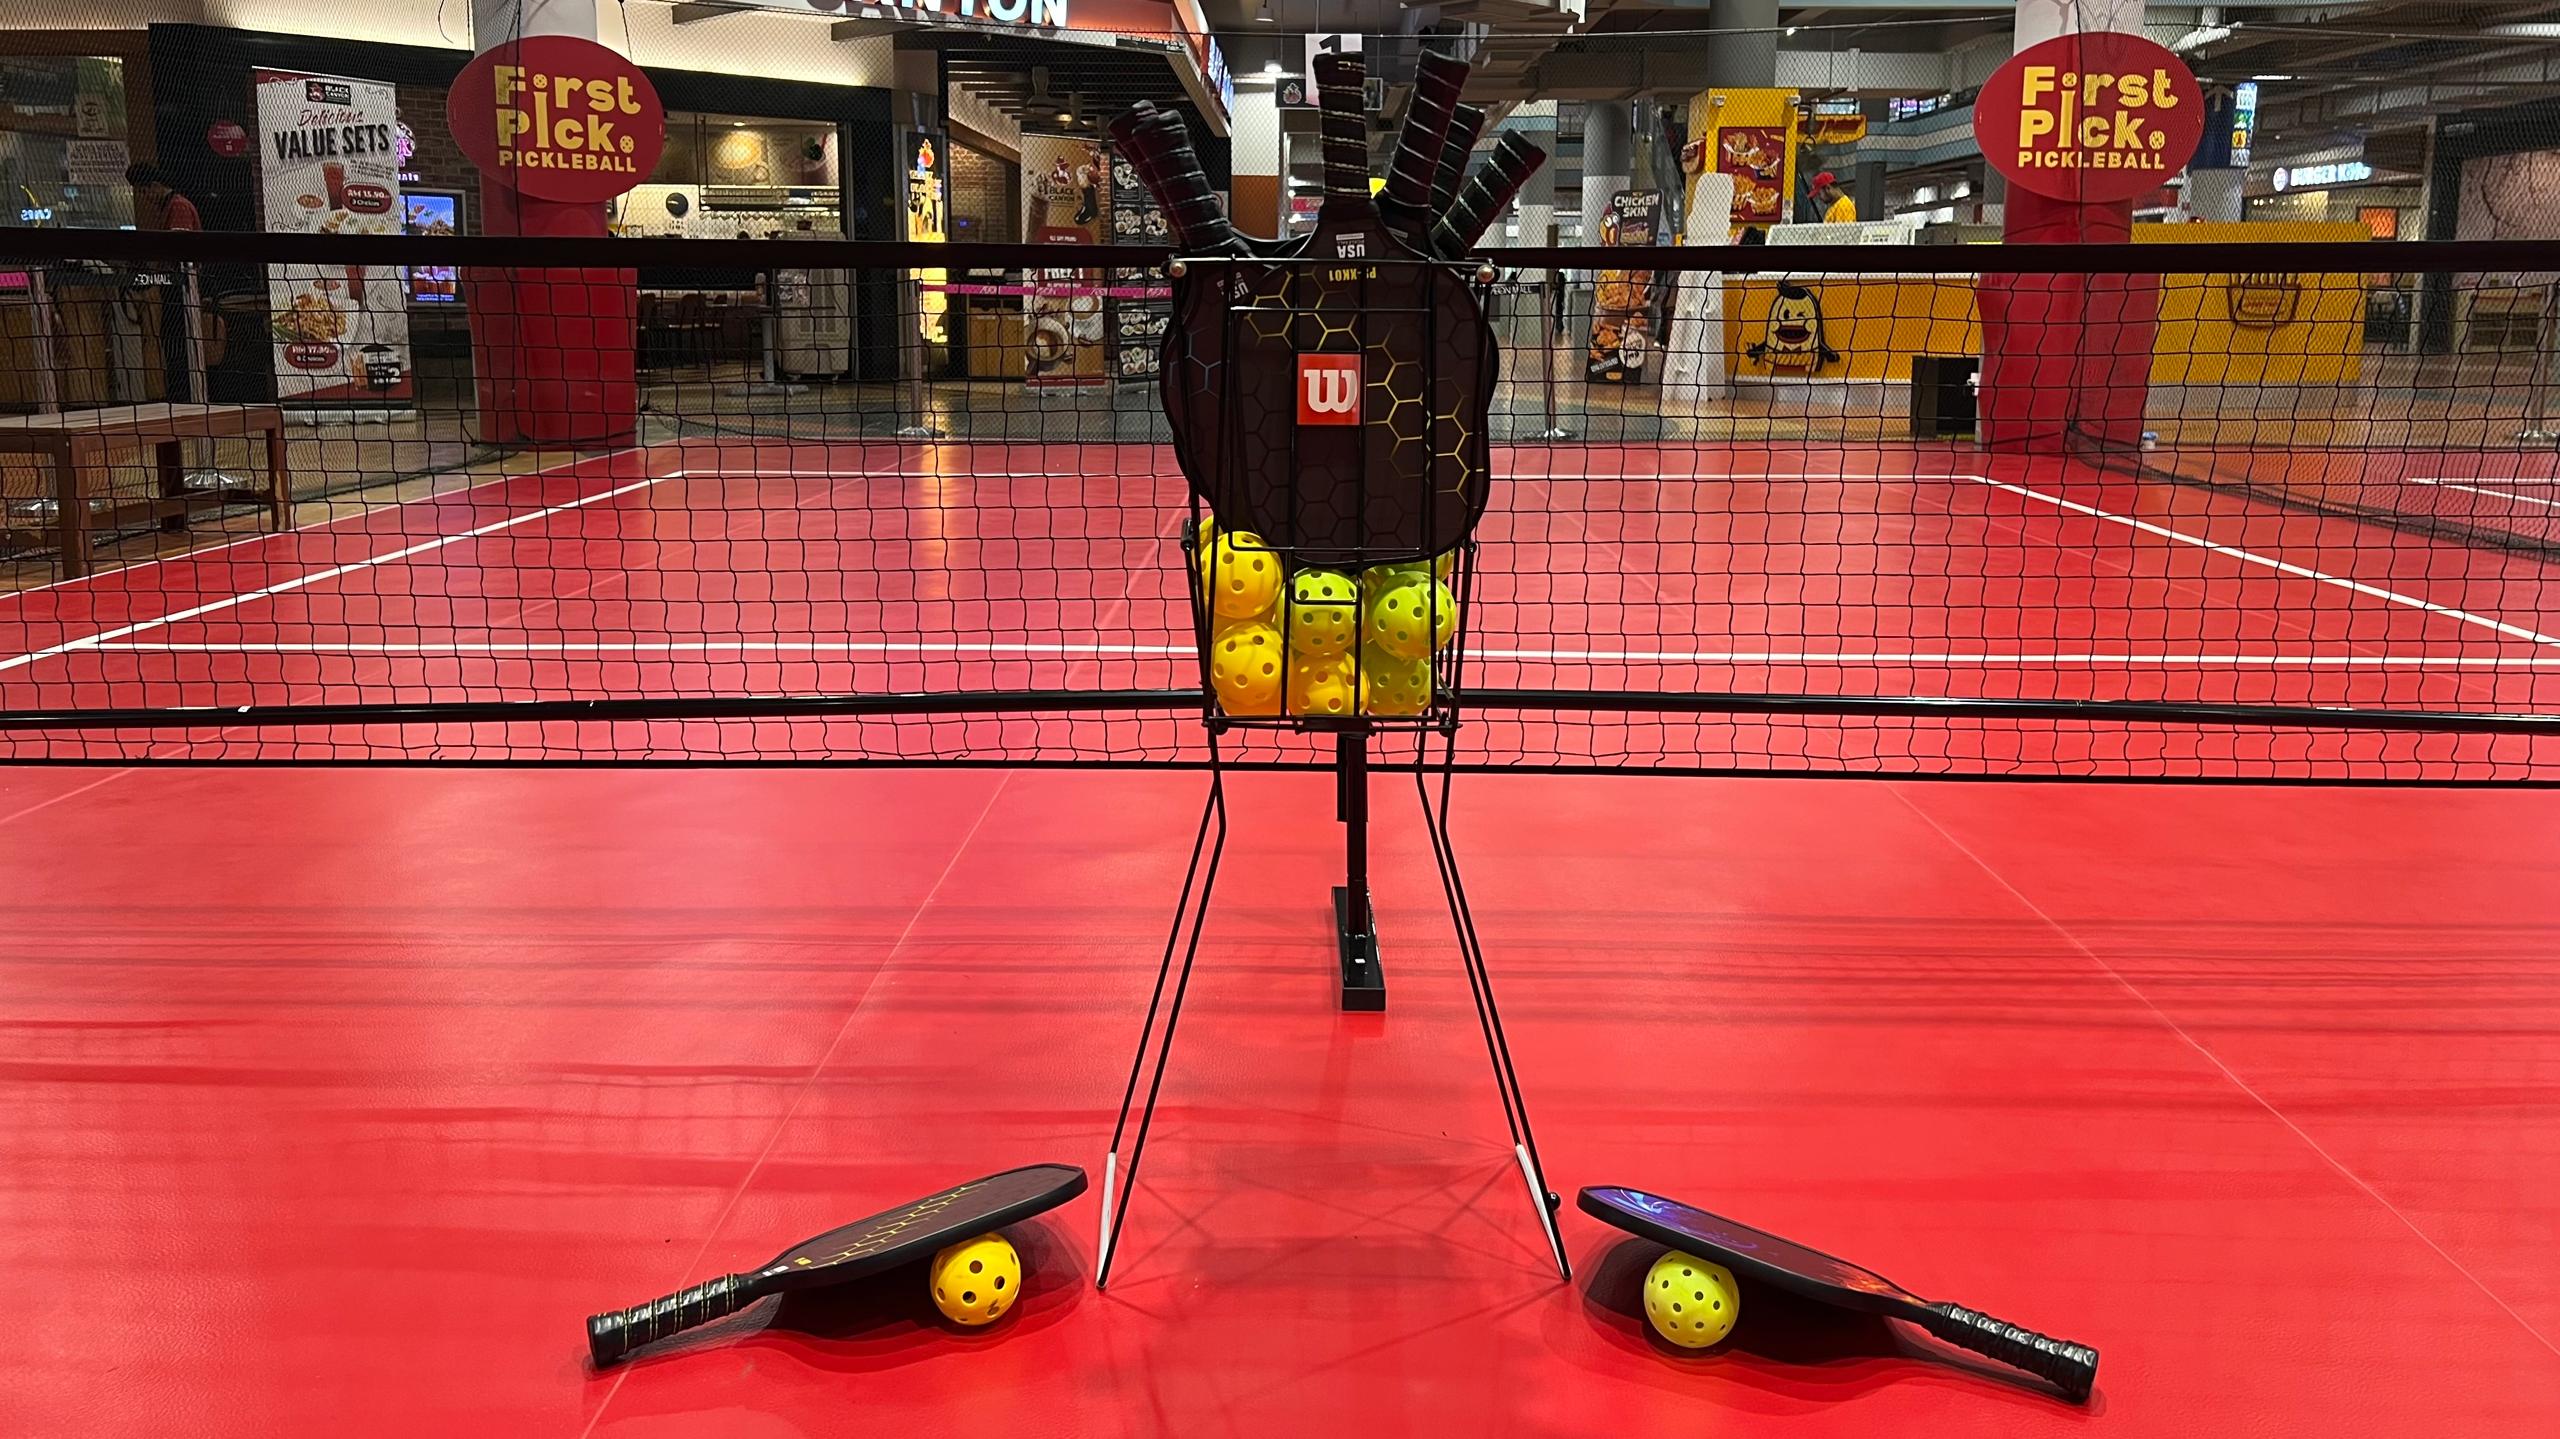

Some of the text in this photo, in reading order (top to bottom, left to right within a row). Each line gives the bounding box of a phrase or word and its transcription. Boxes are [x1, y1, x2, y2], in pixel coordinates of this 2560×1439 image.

[494, 65, 641, 114] First
[2022, 66, 2178, 108] First
[274, 127, 337, 160] VALUE
[342, 124, 390, 154] SETS
[500, 150, 636, 173] PICKLEBALL
[2018, 151, 2165, 169] PICKLEBALL
[1614, 193, 1659, 207] CHICKEN
[1623, 206, 1648, 217] SKIN
[1337, 244, 1365, 258] USA
